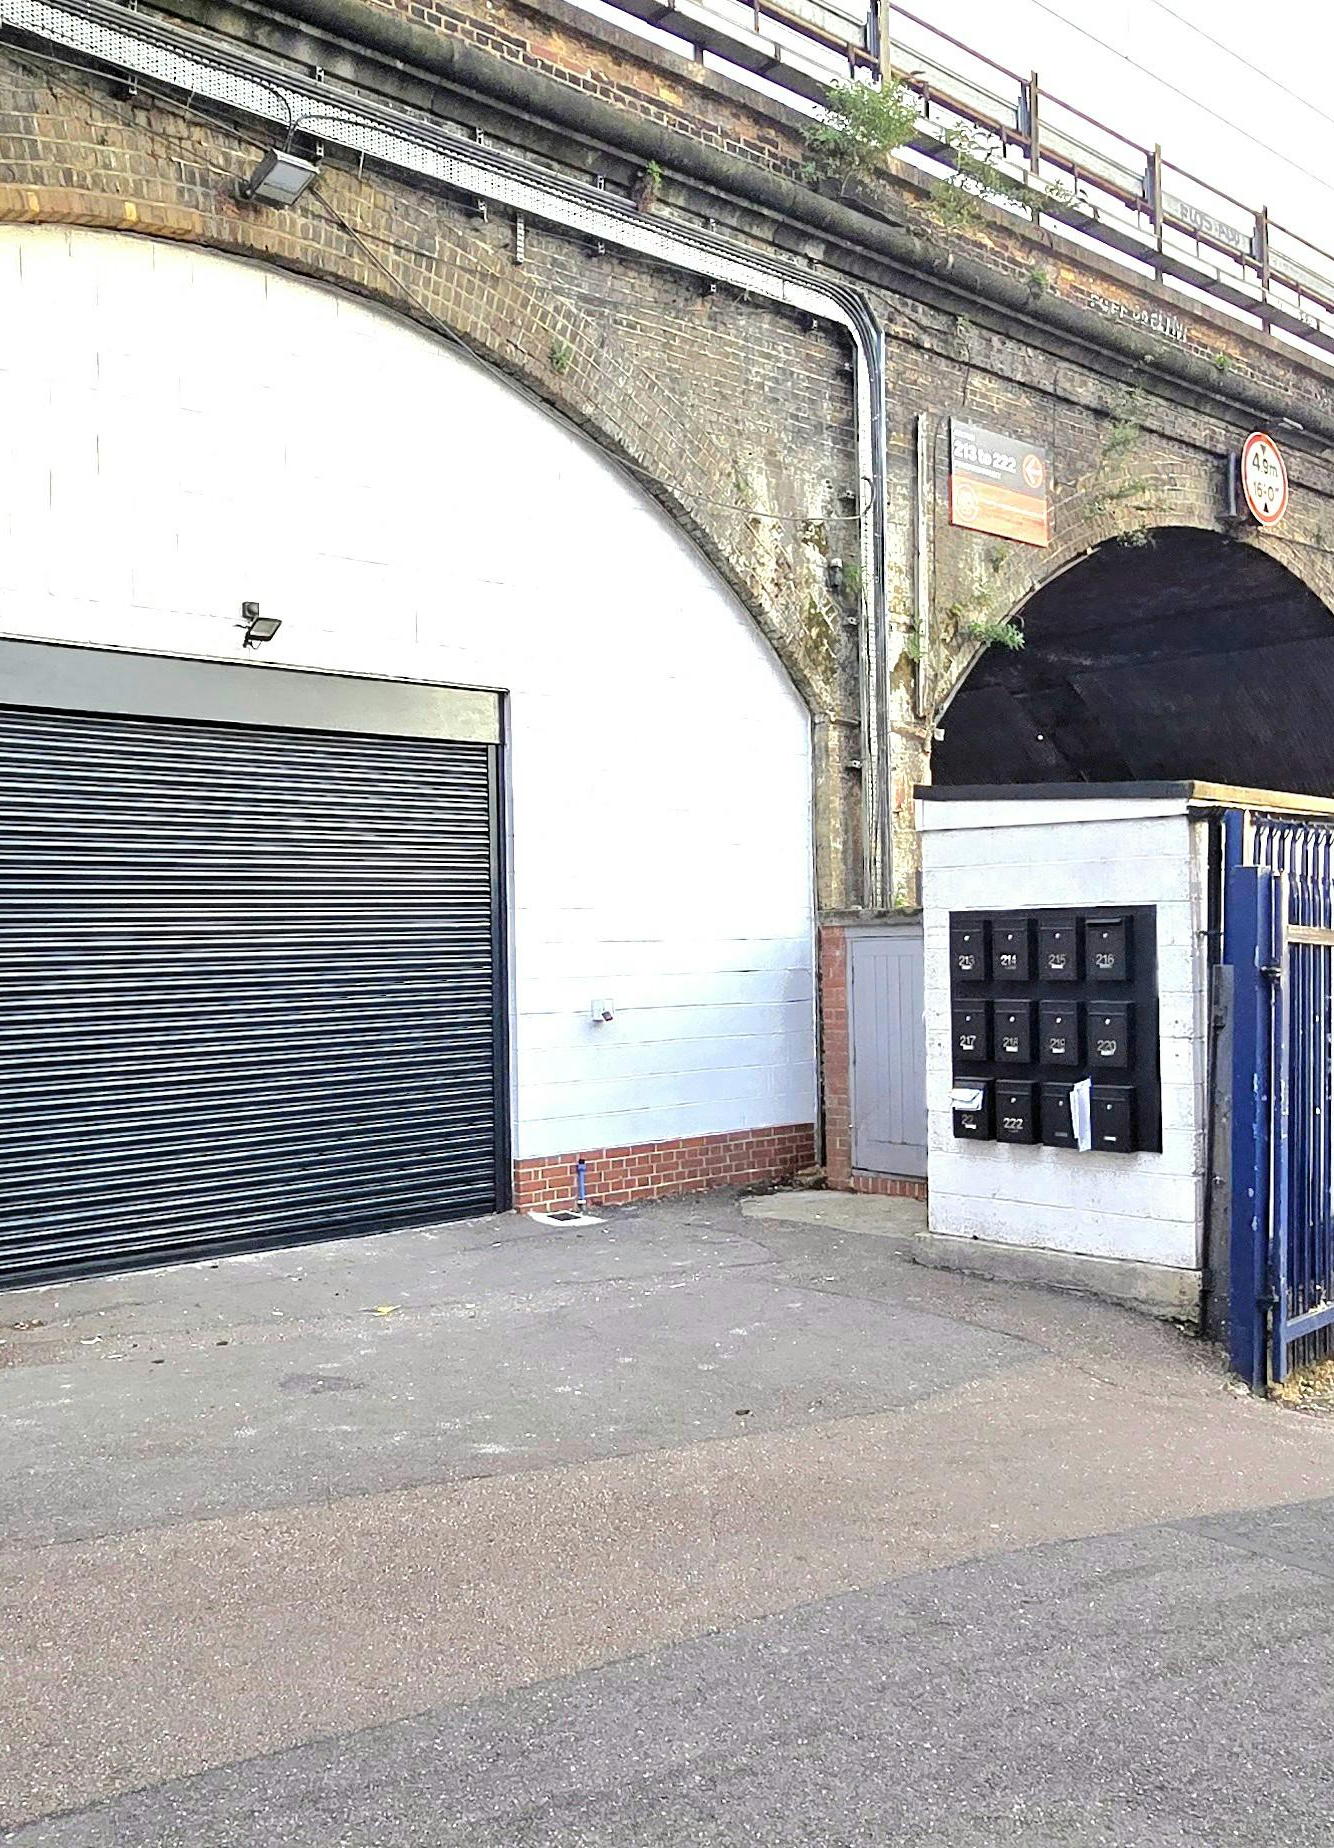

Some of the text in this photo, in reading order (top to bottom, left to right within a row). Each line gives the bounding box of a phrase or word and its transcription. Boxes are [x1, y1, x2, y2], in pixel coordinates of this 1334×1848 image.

[953, 440, 978, 462] 213
[977, 448, 993, 466] to
[992, 451, 1017, 474] 222
[1252, 452, 1279, 477] 4.9m
[958, 954, 975, 967] 213
[1000, 954, 1017, 966] 214
[1048, 953, 1067, 965] 215
[1096, 953, 1115, 966] 216
[959, 1035, 977, 1047] 217
[1097, 1039, 1117, 1053] 220
[1003, 1117, 1024, 1130] 222
